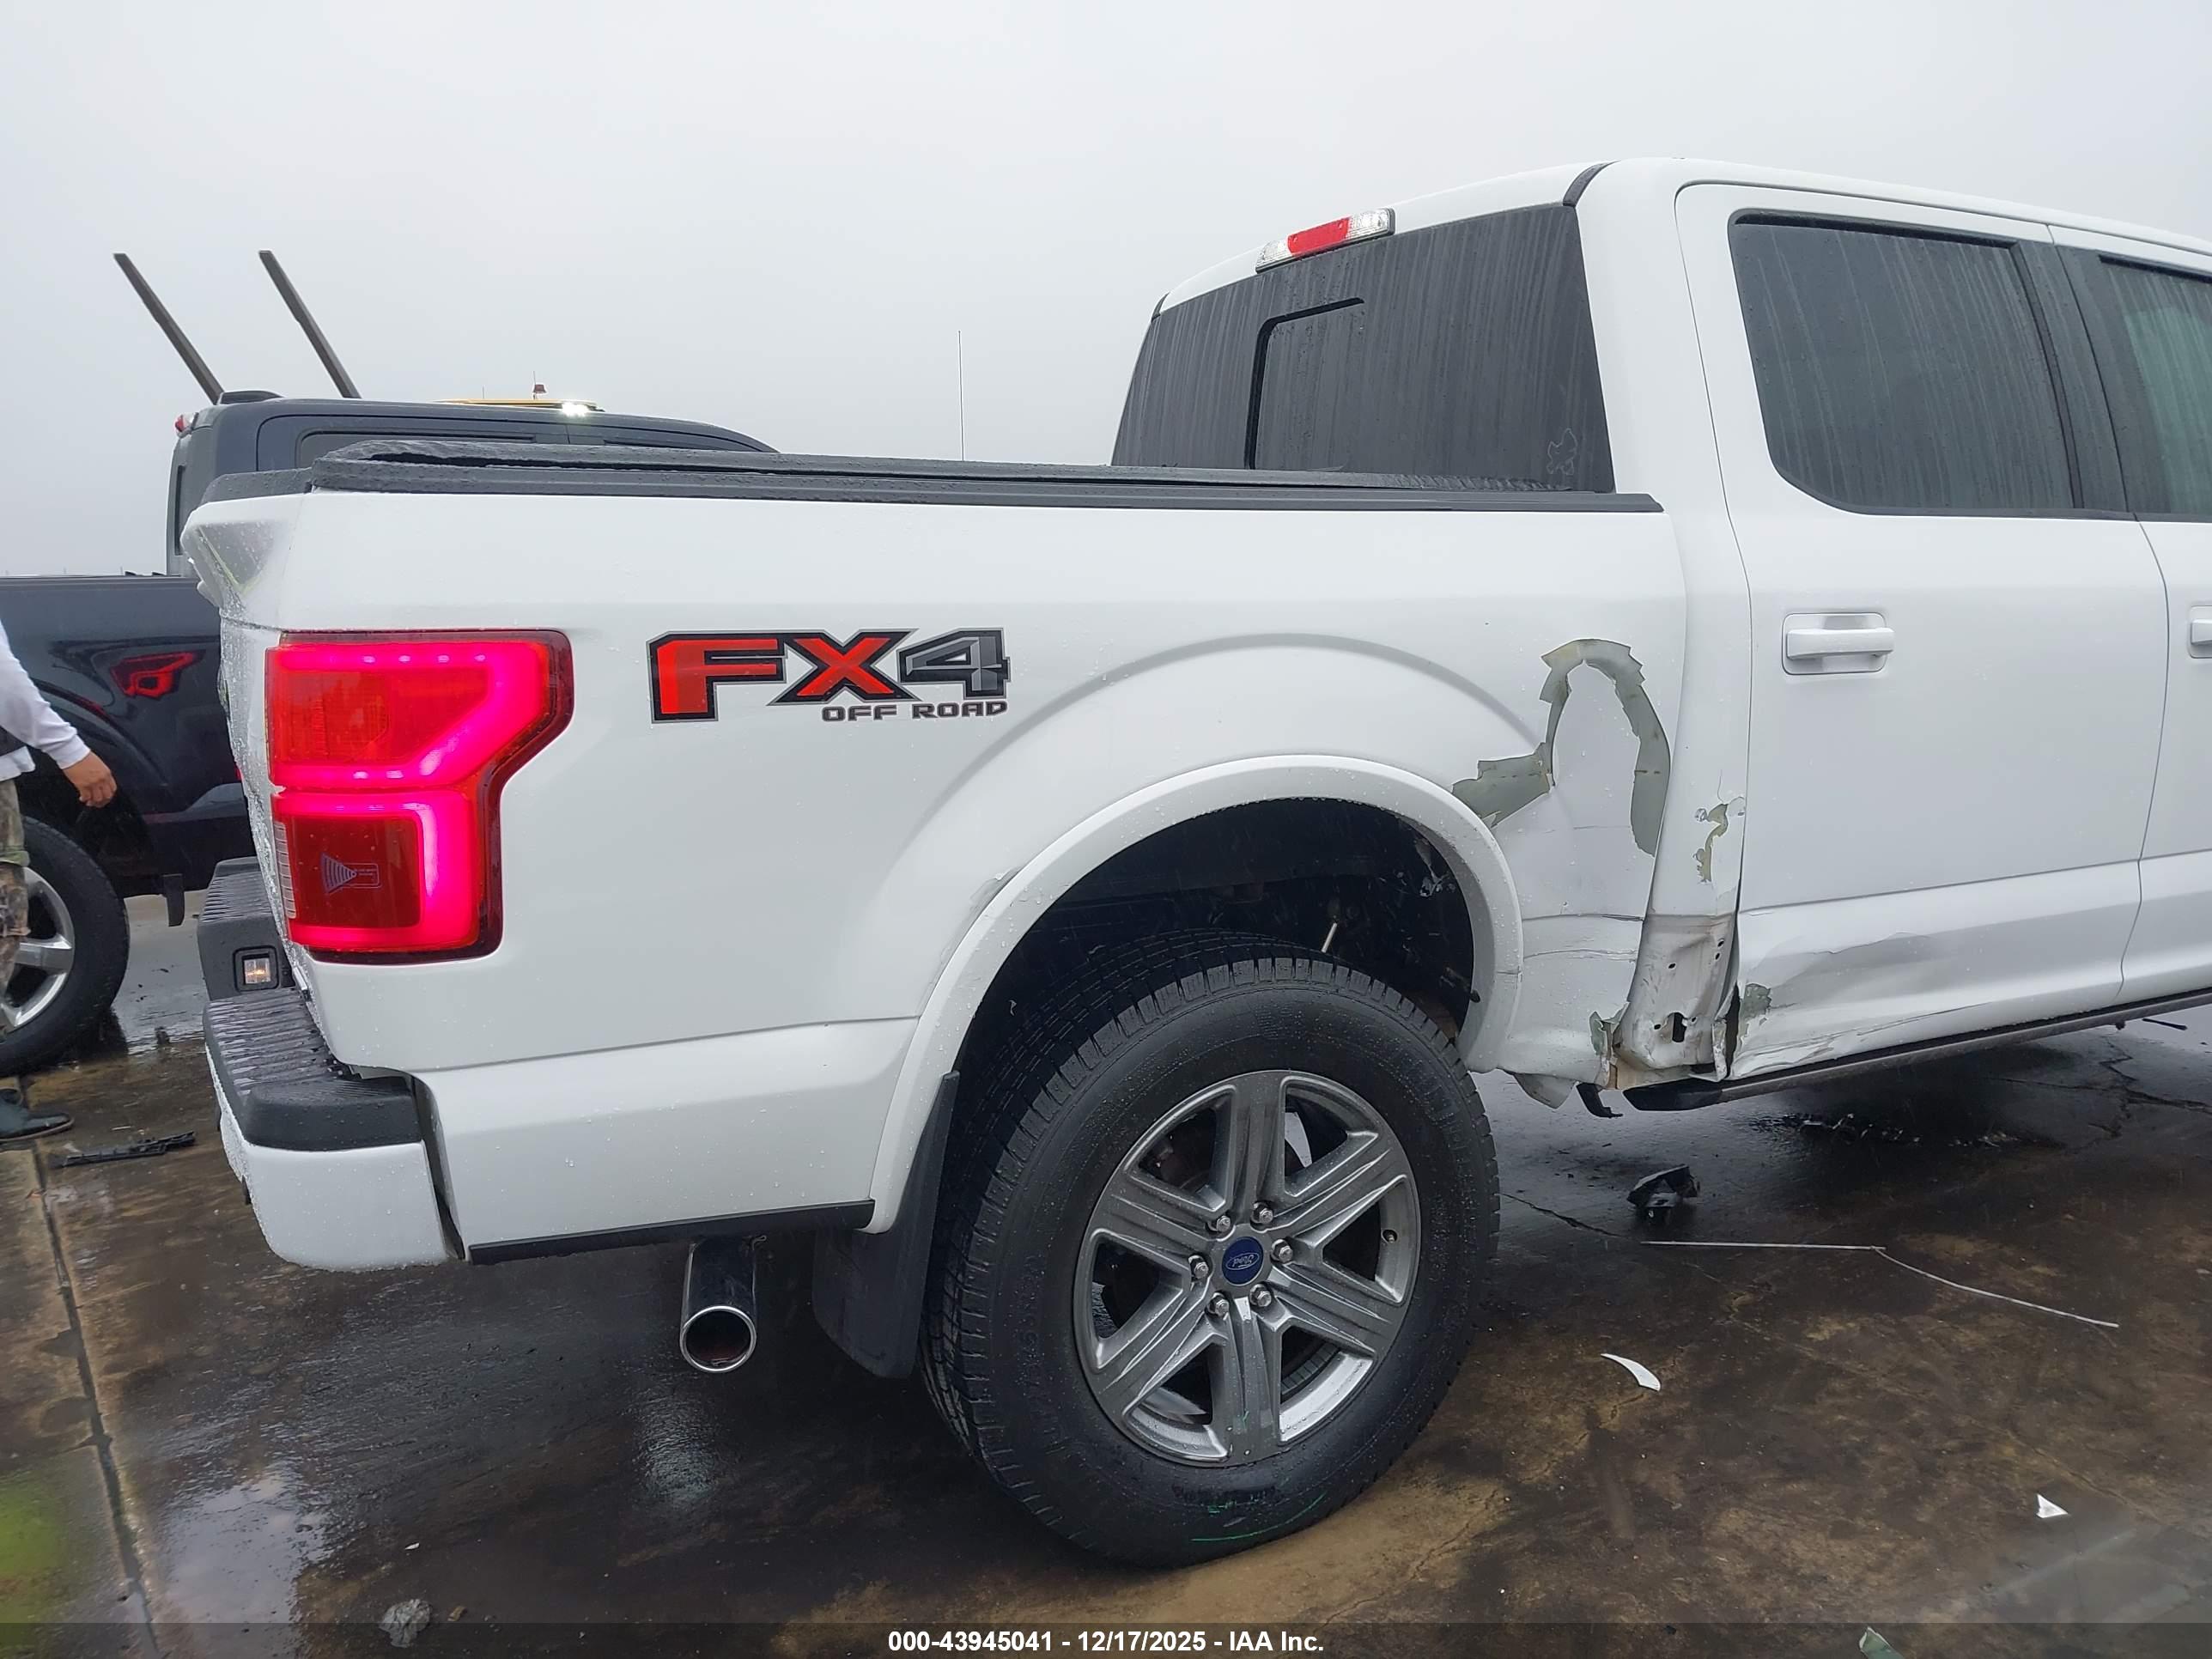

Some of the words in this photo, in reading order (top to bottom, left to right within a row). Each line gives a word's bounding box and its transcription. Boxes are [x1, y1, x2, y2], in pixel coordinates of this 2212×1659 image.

[646, 628, 1011, 723] FX4
[822, 705, 898, 722] OFF
[912, 700, 1008, 720] ROAD
